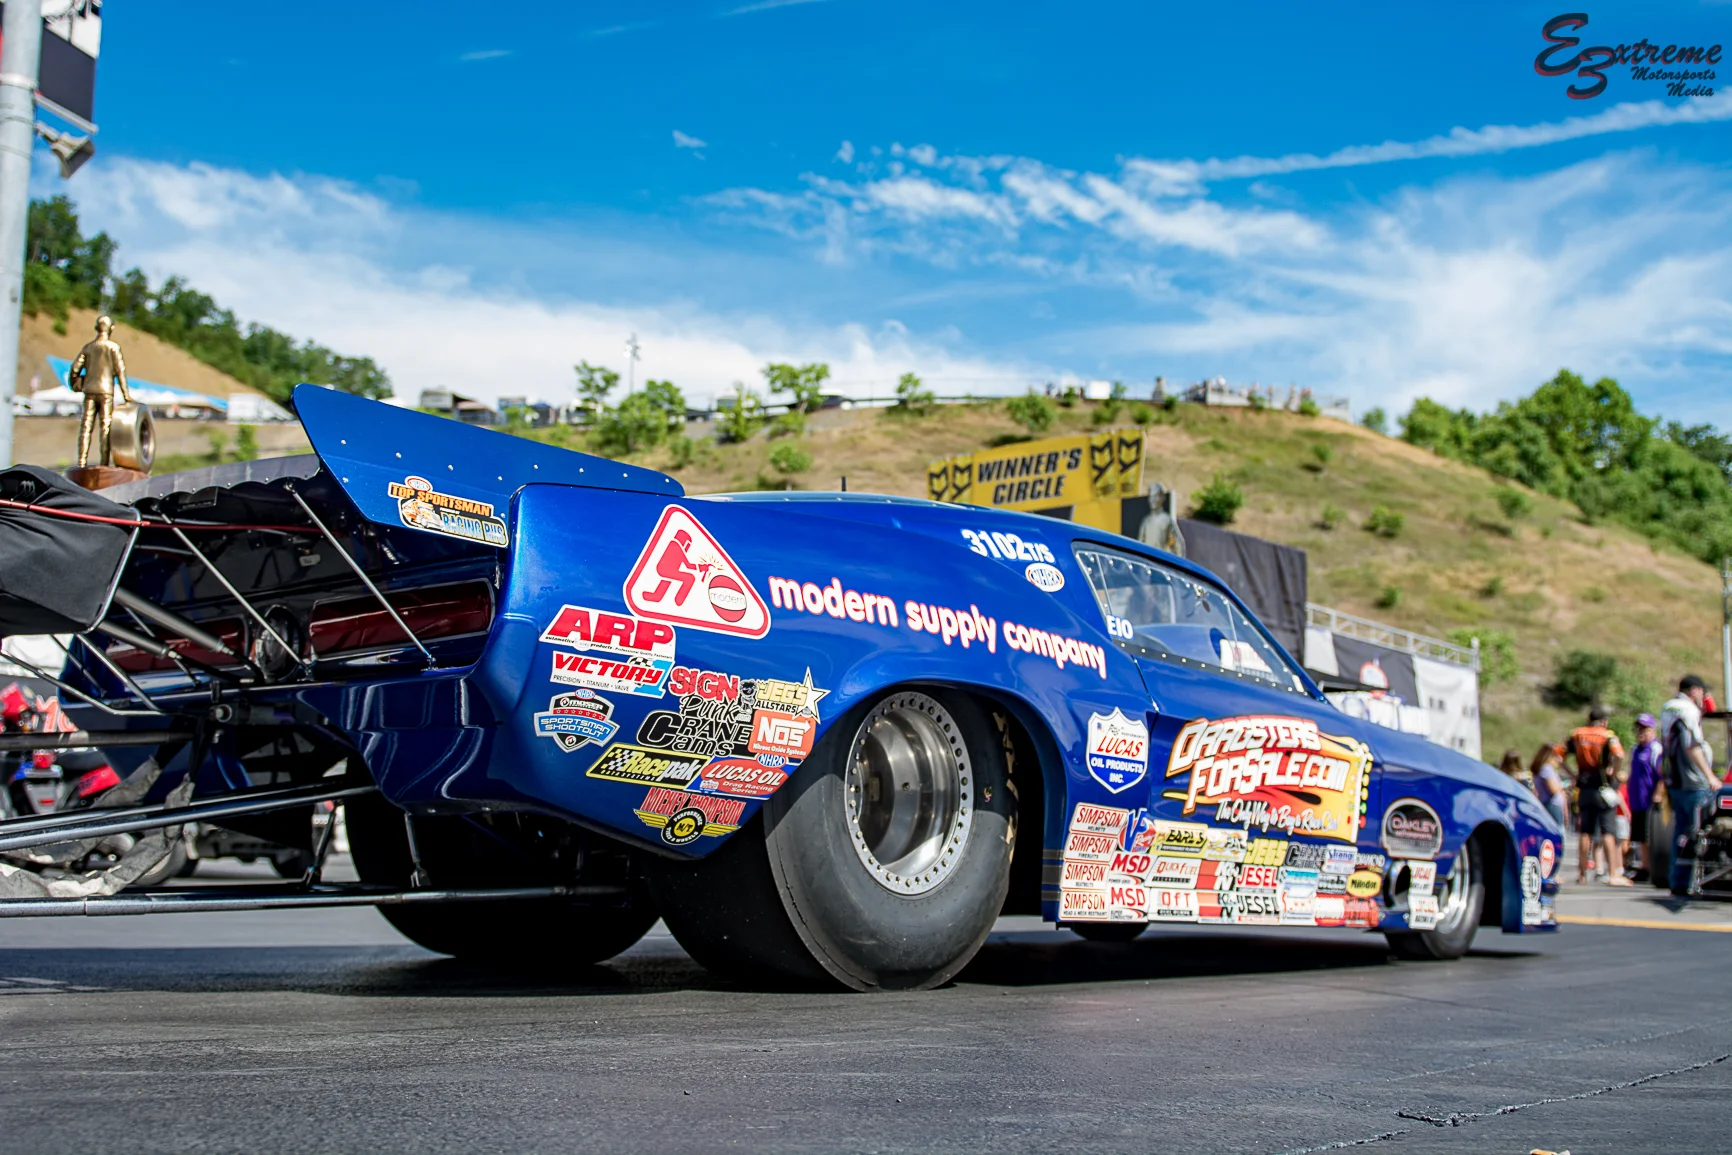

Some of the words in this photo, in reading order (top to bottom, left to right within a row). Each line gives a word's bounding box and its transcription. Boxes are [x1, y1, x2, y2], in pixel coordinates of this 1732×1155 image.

[977, 447, 1083, 484] WINNER'S
[392, 484, 415, 499] TOP
[417, 490, 491, 517] SPORTSMAN
[993, 474, 1066, 506] CIRCLE
[711, 592, 745, 604] modern
[547, 608, 674, 651] ARP
[767, 575, 899, 627] modern
[905, 599, 996, 653] supply
[1002, 620, 1107, 680] company
[555, 653, 663, 684] VICTORY
[553, 674, 581, 684] PRECISION
[586, 679, 610, 689] TITANIUM
[670, 667, 739, 701] SIGN
[757, 680, 808, 706] JEG'S
[755, 700, 797, 714] ALLSTARS
[541, 718, 610, 734] SPORTSMAN
[545, 724, 604, 738] SHOOTOUT
[757, 716, 811, 747] NOS
[1097, 735, 1143, 757] LUCAS
[1170, 717, 1321, 773] DRAGSTERS
[620, 750, 701, 781] Racepak
[758, 753, 786, 767] NHRA
[1091, 757, 1104, 768] OIL
[1106, 759, 1143, 774] PRODUCTS
[705, 764, 762, 783] LUCAS
[757, 770, 785, 787] OIL
[1109, 772, 1124, 783] INC.
[722, 781, 743, 789] Drag
[745, 783, 773, 792] Racing
[730, 787, 757, 795] Series
[640, 786, 691, 817] MICKEY
[688, 793, 746, 825] THOMPSON
[1076, 807, 1123, 829] SIMPSON
[1392, 817, 1437, 833] OAKLEY
[1069, 835, 1113, 854] SIMPSON
[1065, 863, 1106, 882] SIMPSON
[1111, 853, 1151, 874] MSD
[1237, 866, 1278, 887] JESEL
[1064, 893, 1105, 910] SIMPSON
[1111, 887, 1146, 907] MSD
[1238, 895, 1280, 915] JESEL
